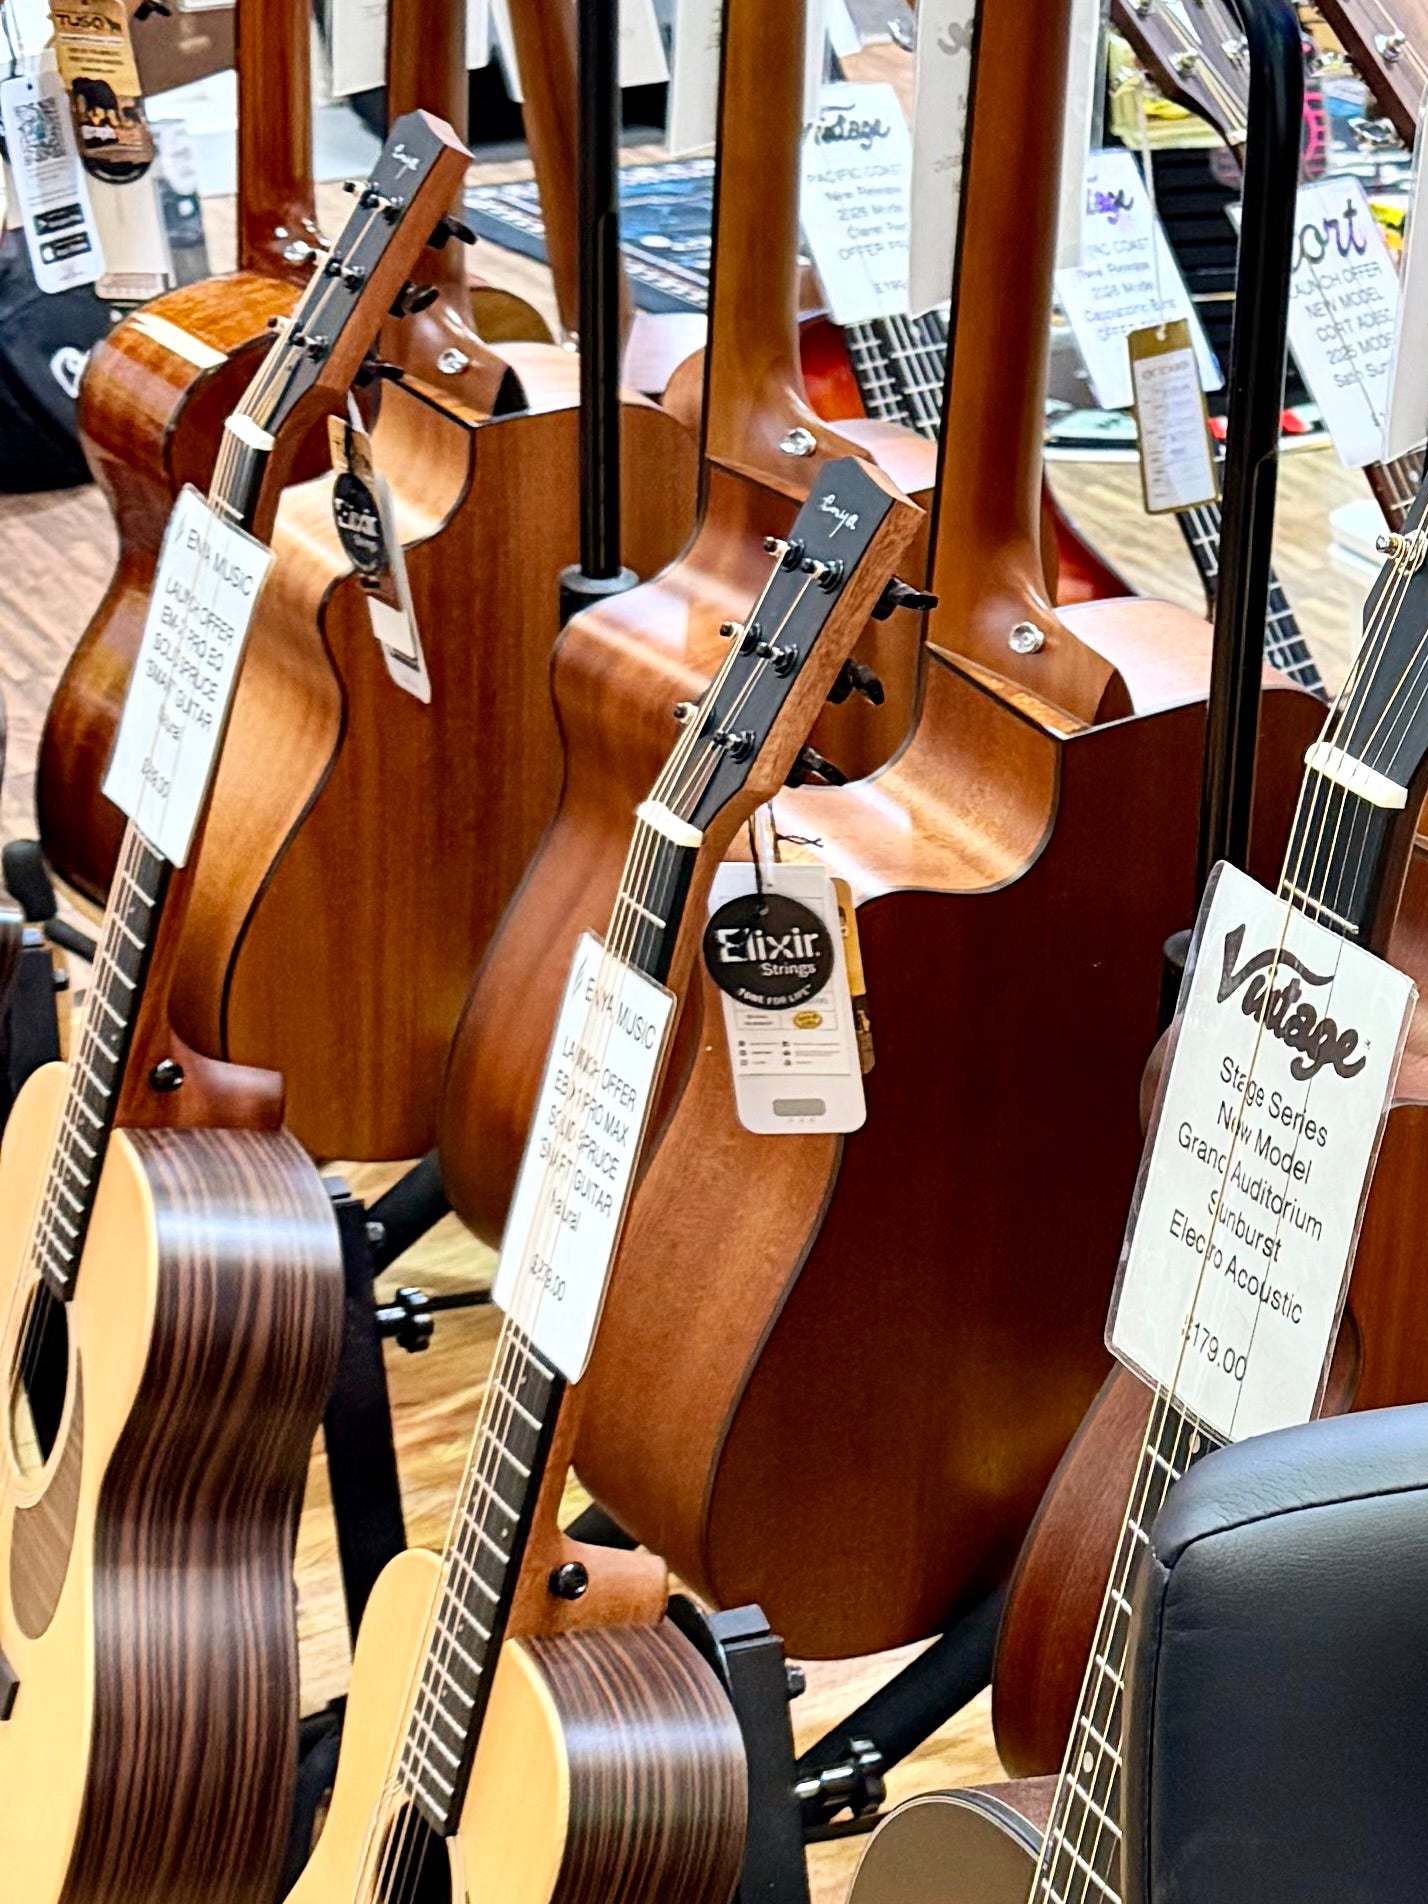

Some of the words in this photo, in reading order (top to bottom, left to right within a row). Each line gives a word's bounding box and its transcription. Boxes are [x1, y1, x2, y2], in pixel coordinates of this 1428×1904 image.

[760, 961, 817, 979] Strings
[1215, 923, 1367, 1082] Vintage
[616, 1000, 658, 1052] MUSIC
[600, 1067, 638, 1114] OFFER
[1219, 1055, 1267, 1109] Stage
[1267, 1090, 1330, 1148] Series
[603, 1113, 630, 1149] MAX
[1216, 1100, 1252, 1146] New
[1252, 1126, 1312, 1186] Model
[572, 1169, 614, 1219] GUITAR
[1206, 1188, 1283, 1264] Sunburst
[1228, 1160, 1323, 1242] Auditorium
[1224, 1258, 1305, 1325] Acoustic
